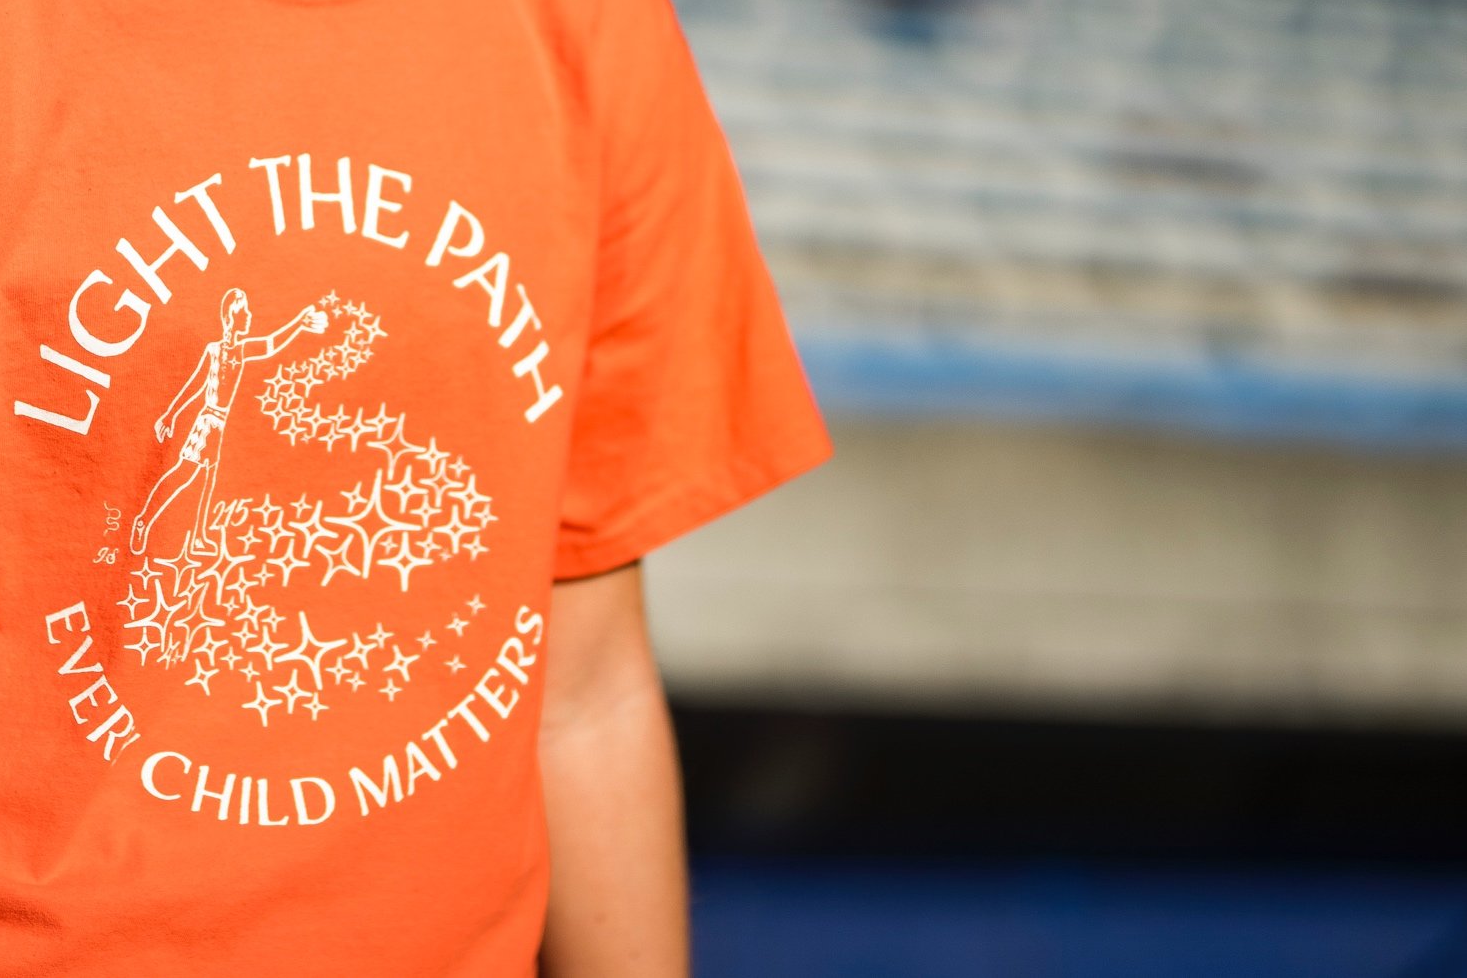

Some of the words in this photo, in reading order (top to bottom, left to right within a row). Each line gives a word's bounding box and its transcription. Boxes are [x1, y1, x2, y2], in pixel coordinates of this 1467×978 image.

[14, 173, 236, 435] LIGHT
[249, 152, 413, 250] THE
[425, 200, 564, 423] PATH
[209, 498, 253, 530] 215
[140, 750, 335, 826] CHILD
[349, 605, 543, 816] MATTERS
